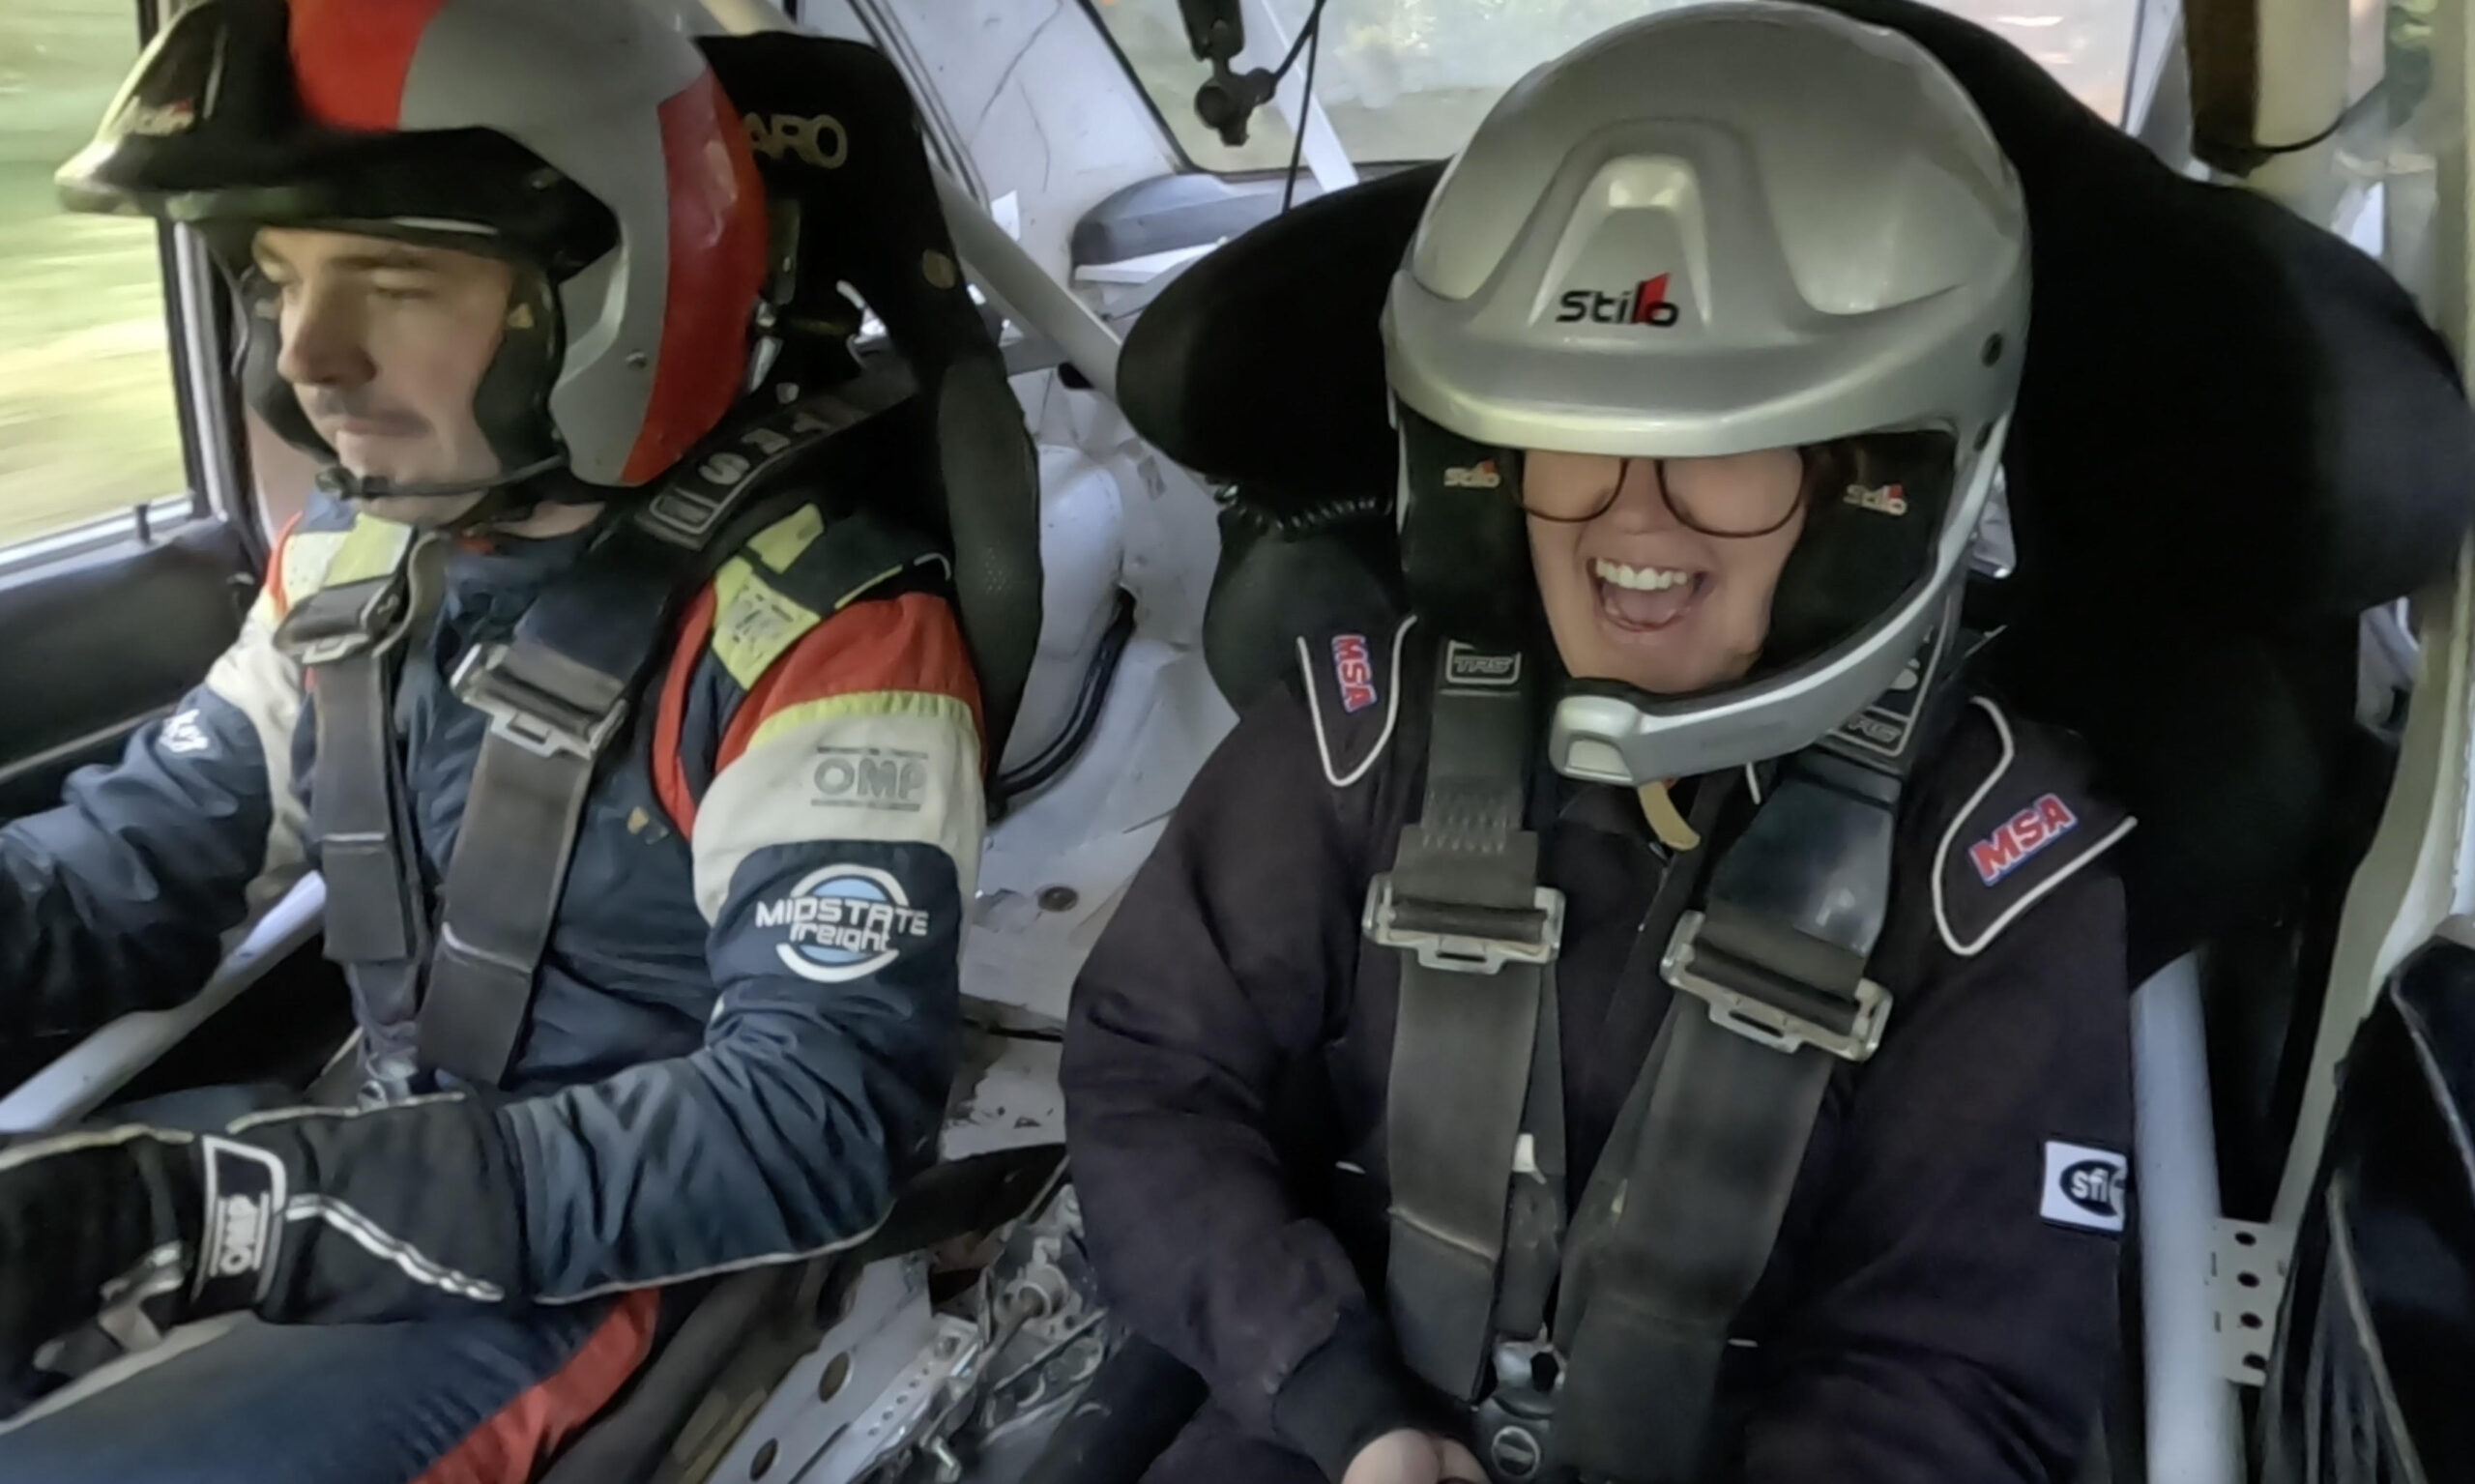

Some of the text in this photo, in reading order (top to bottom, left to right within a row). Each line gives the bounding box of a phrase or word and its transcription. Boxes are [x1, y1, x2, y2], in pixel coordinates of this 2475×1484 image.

[1556, 272, 1679, 327] Stilo
[1330, 634, 1378, 713] MSA
[1453, 655, 1514, 674] TRS
[814, 757, 927, 800] OMP
[1968, 793, 2078, 887] MSA
[755, 897, 929, 937] MIDSTATE
